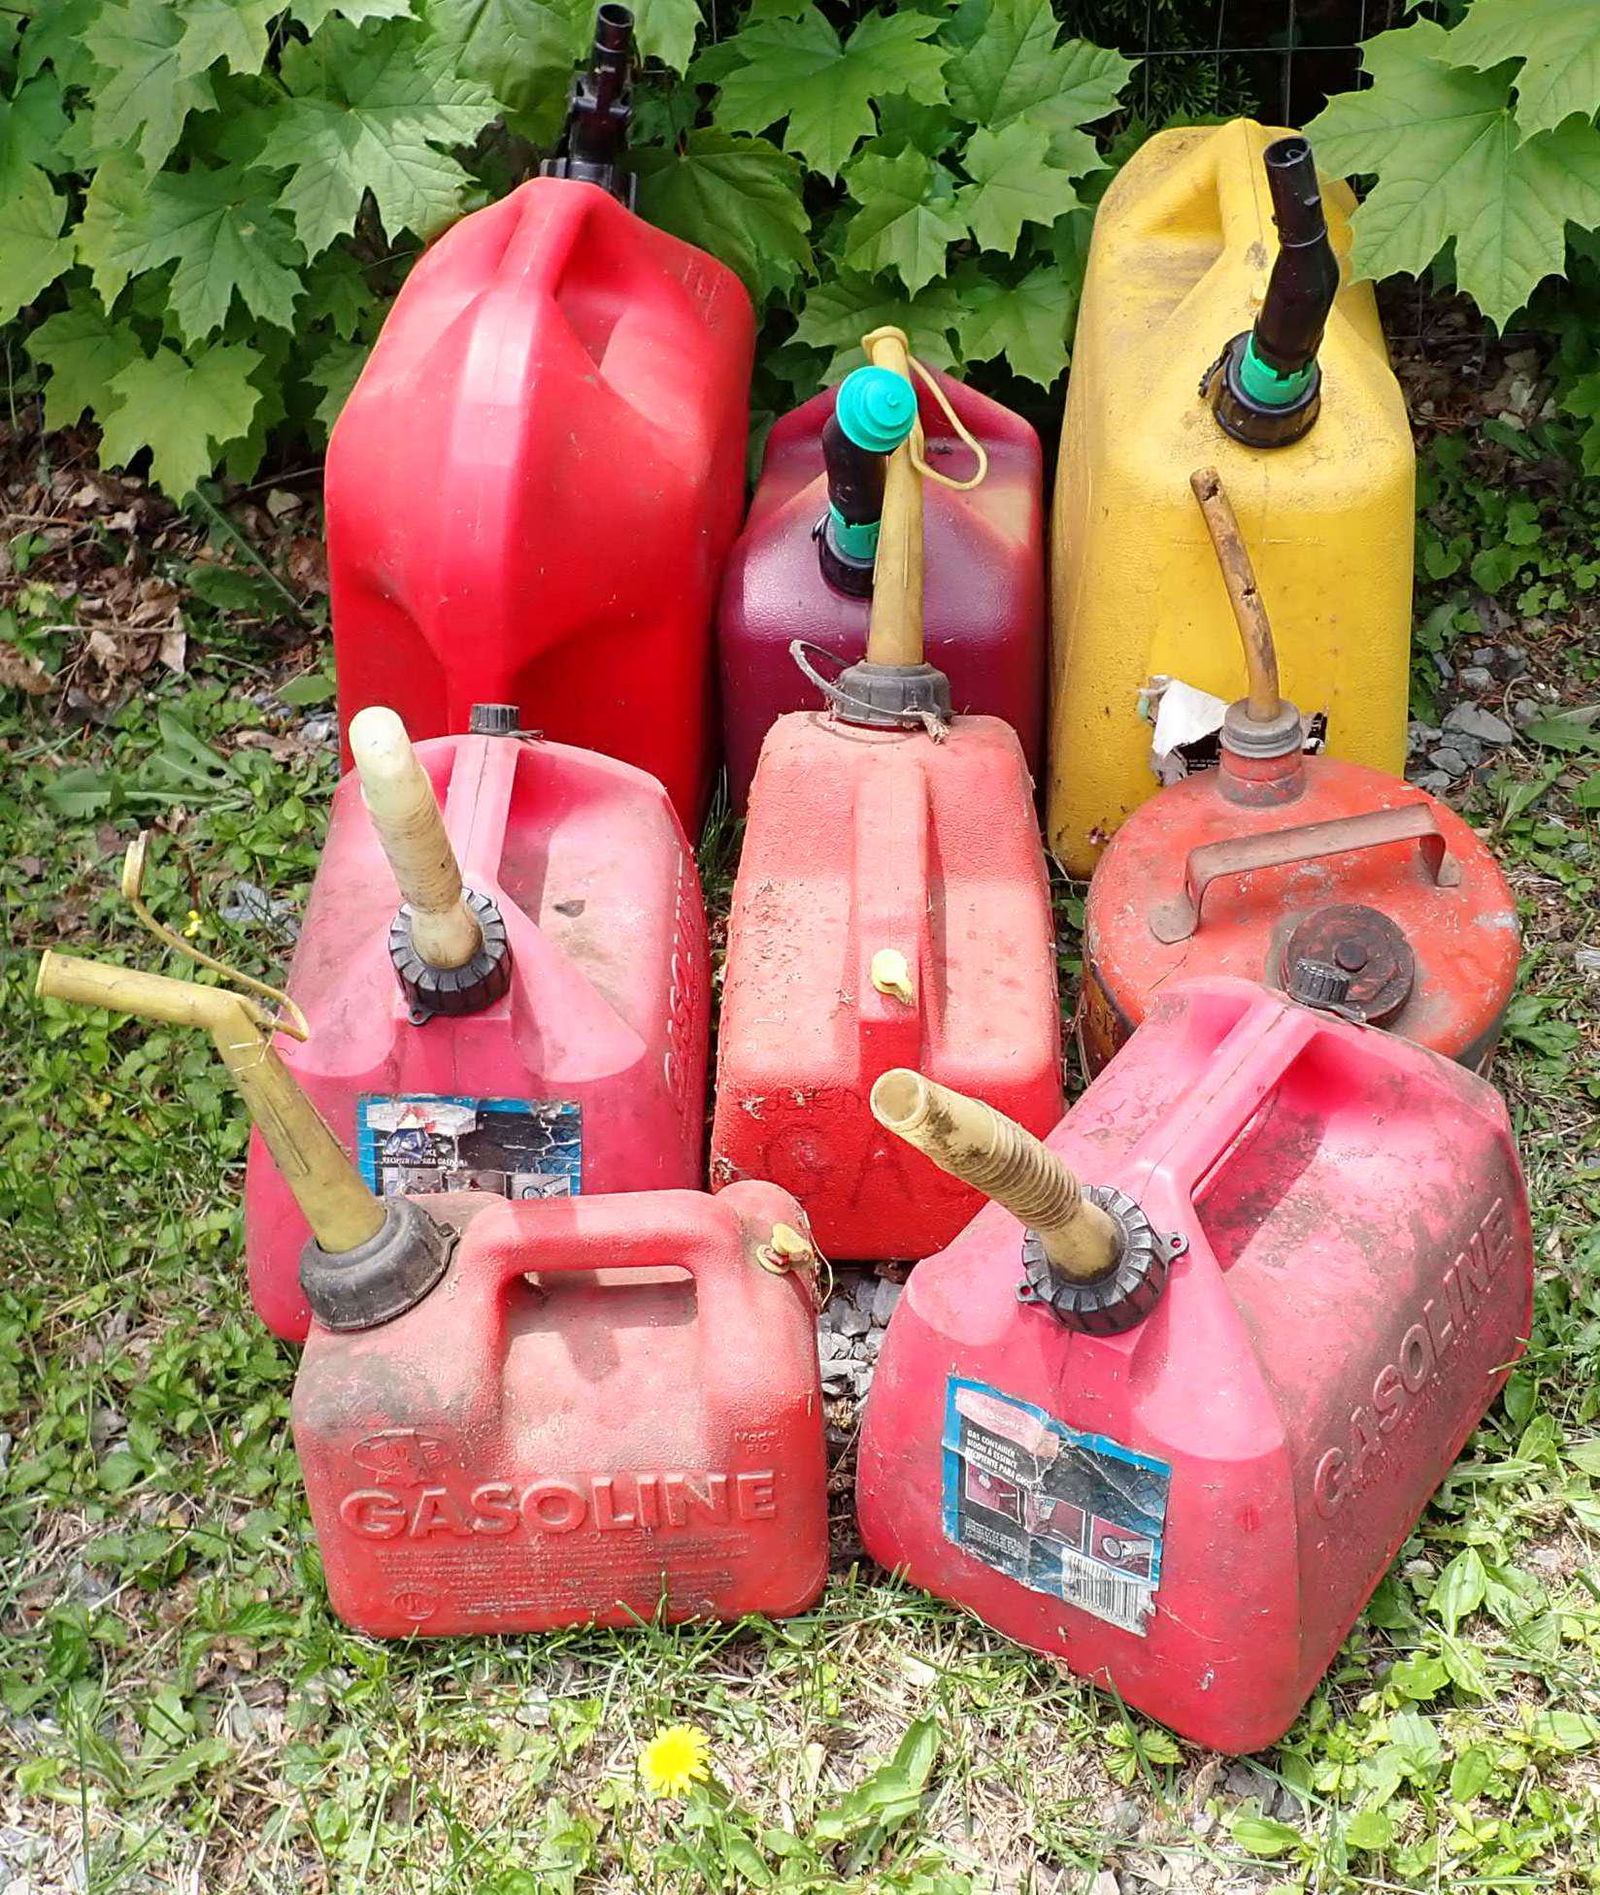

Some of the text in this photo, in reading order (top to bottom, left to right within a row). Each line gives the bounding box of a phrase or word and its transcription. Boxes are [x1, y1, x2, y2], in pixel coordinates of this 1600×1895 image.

[1314, 1197, 1508, 1518] GASOLINE
[967, 1430, 1015, 1459] GAS CONTAINER
[998, 1462, 1015, 1479] PARA
[340, 1470, 777, 1539] GASOLINE
